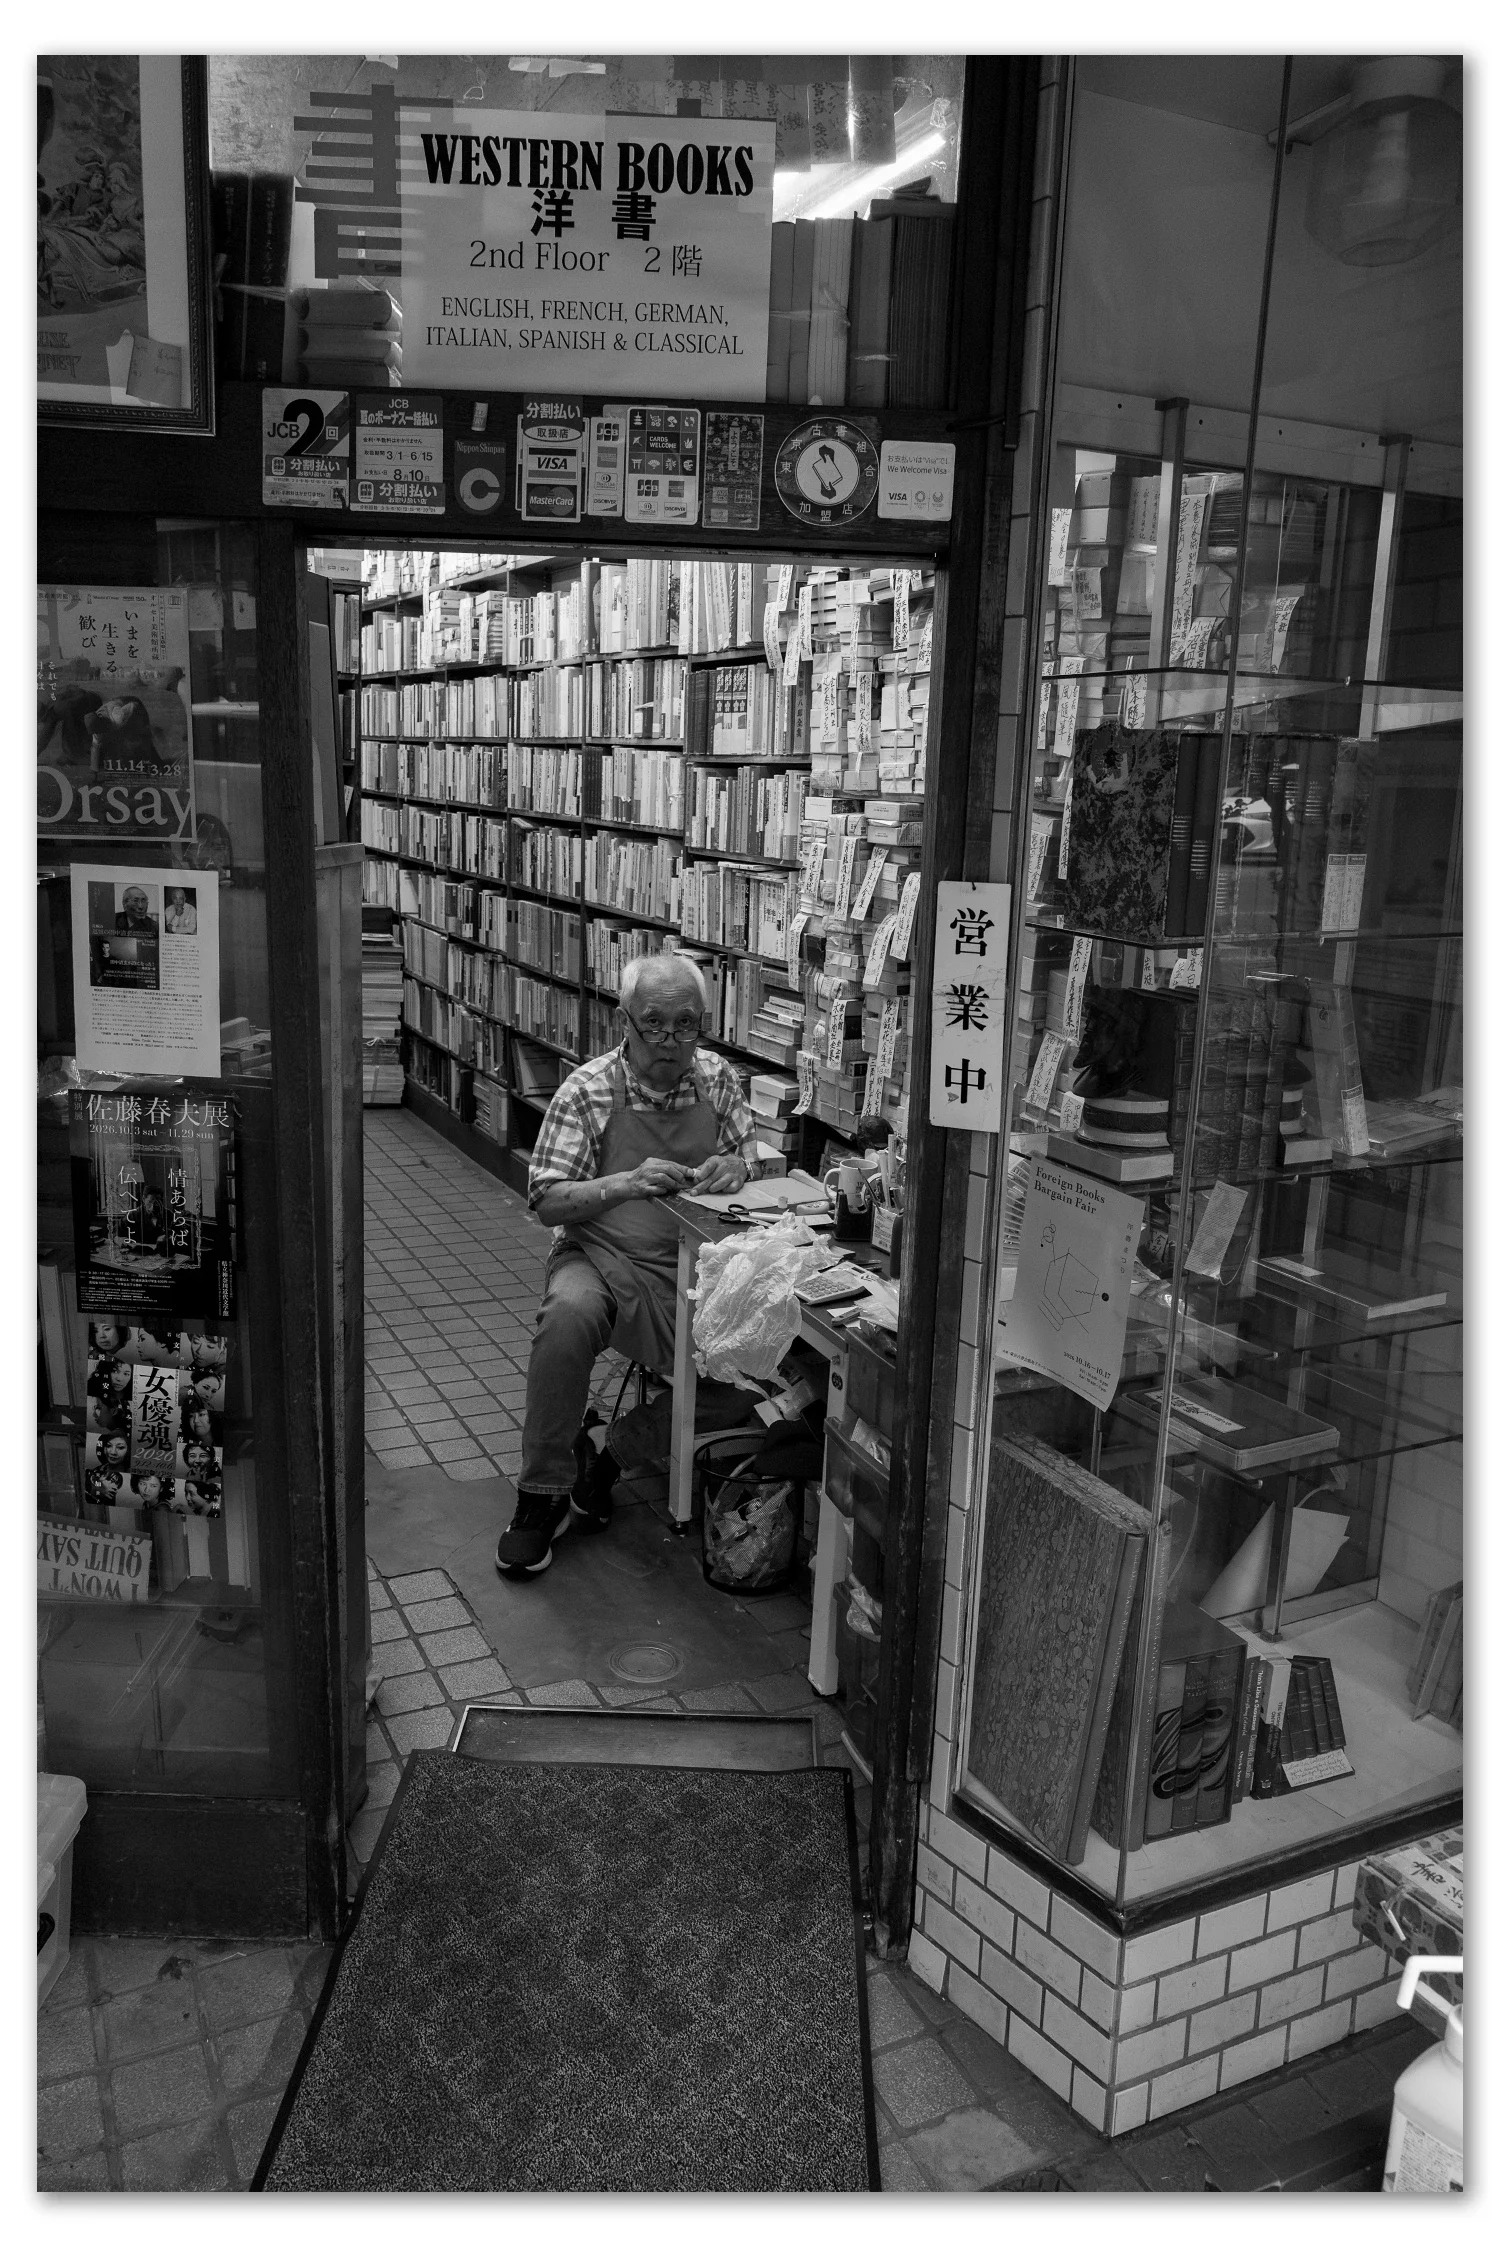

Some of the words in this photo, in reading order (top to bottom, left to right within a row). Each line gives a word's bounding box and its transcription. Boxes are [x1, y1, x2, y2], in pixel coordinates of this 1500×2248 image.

[421, 132, 604, 191] WESTERN
[617, 142, 754, 197] BOOKS
[530, 190, 658, 241] 洋書
[469, 240, 524, 270] 2nd
[535, 243, 610, 272] Floor
[441, 296, 534, 323] ENGLISH,
[540, 299, 629, 324] FRENCH,
[634, 303, 729, 328] GERMAN,
[425, 325, 513, 351] ITALIAN,
[518, 329, 606, 352] SPANISH
[613, 332, 628, 351] &
[634, 333, 744, 355] CLASSICAL
[359, 410, 438, 426] 夏のボーナス一括払い
[388, 398, 409, 410] JCB
[525, 402, 581, 420] 分割払い
[267, 422, 300, 439] JCB
[537, 427, 569, 439] 取扱店
[290, 458, 341, 472] 分割払い
[297, 471, 332, 479] お取り扱い店
[537, 457, 568, 470] VISA
[887, 465, 899, 473] We
[900, 466, 932, 474] Welcome
[933, 467, 947, 475] Visa
[378, 482, 437, 498] 分割払い
[388, 496, 427, 505] お取り扱い店
[529, 495, 574, 507] MasterCard
[888, 492, 908, 501] VISA
[799, 501, 854, 523] 加盟店
[78, 613, 97, 649] 歓び
[124, 609, 140, 659] いまを
[101, 623, 120, 673] 生きる
[107, 759, 145, 773] 11.14
[150, 764, 182, 777] 3.28
[945, 906, 996, 1105] 営業中
[73, 1092, 84, 1121] 特別展
[85, 1093, 230, 1128] 佐藤春夫展
[89, 1124, 141, 1136] 2026.10.3
[142, 1127, 157, 1137] sat
[195, 1131, 214, 1140] sun
[1034, 1180, 1073, 1203] Bargain
[1075, 1196, 1097, 1214] Fair
[1035, 1166, 1074, 1192] Foreign
[1075, 1183, 1106, 1204] Books
[118, 1165, 138, 1245] 伝へてよ
[168, 1167, 190, 1247] 情あらば
[137, 1366, 175, 1452] 女優魂
[132, 1447, 176, 1462] 2026
[85, 1542, 143, 1579] QUIT
[48, 1568, 123, 1601] WON'T
